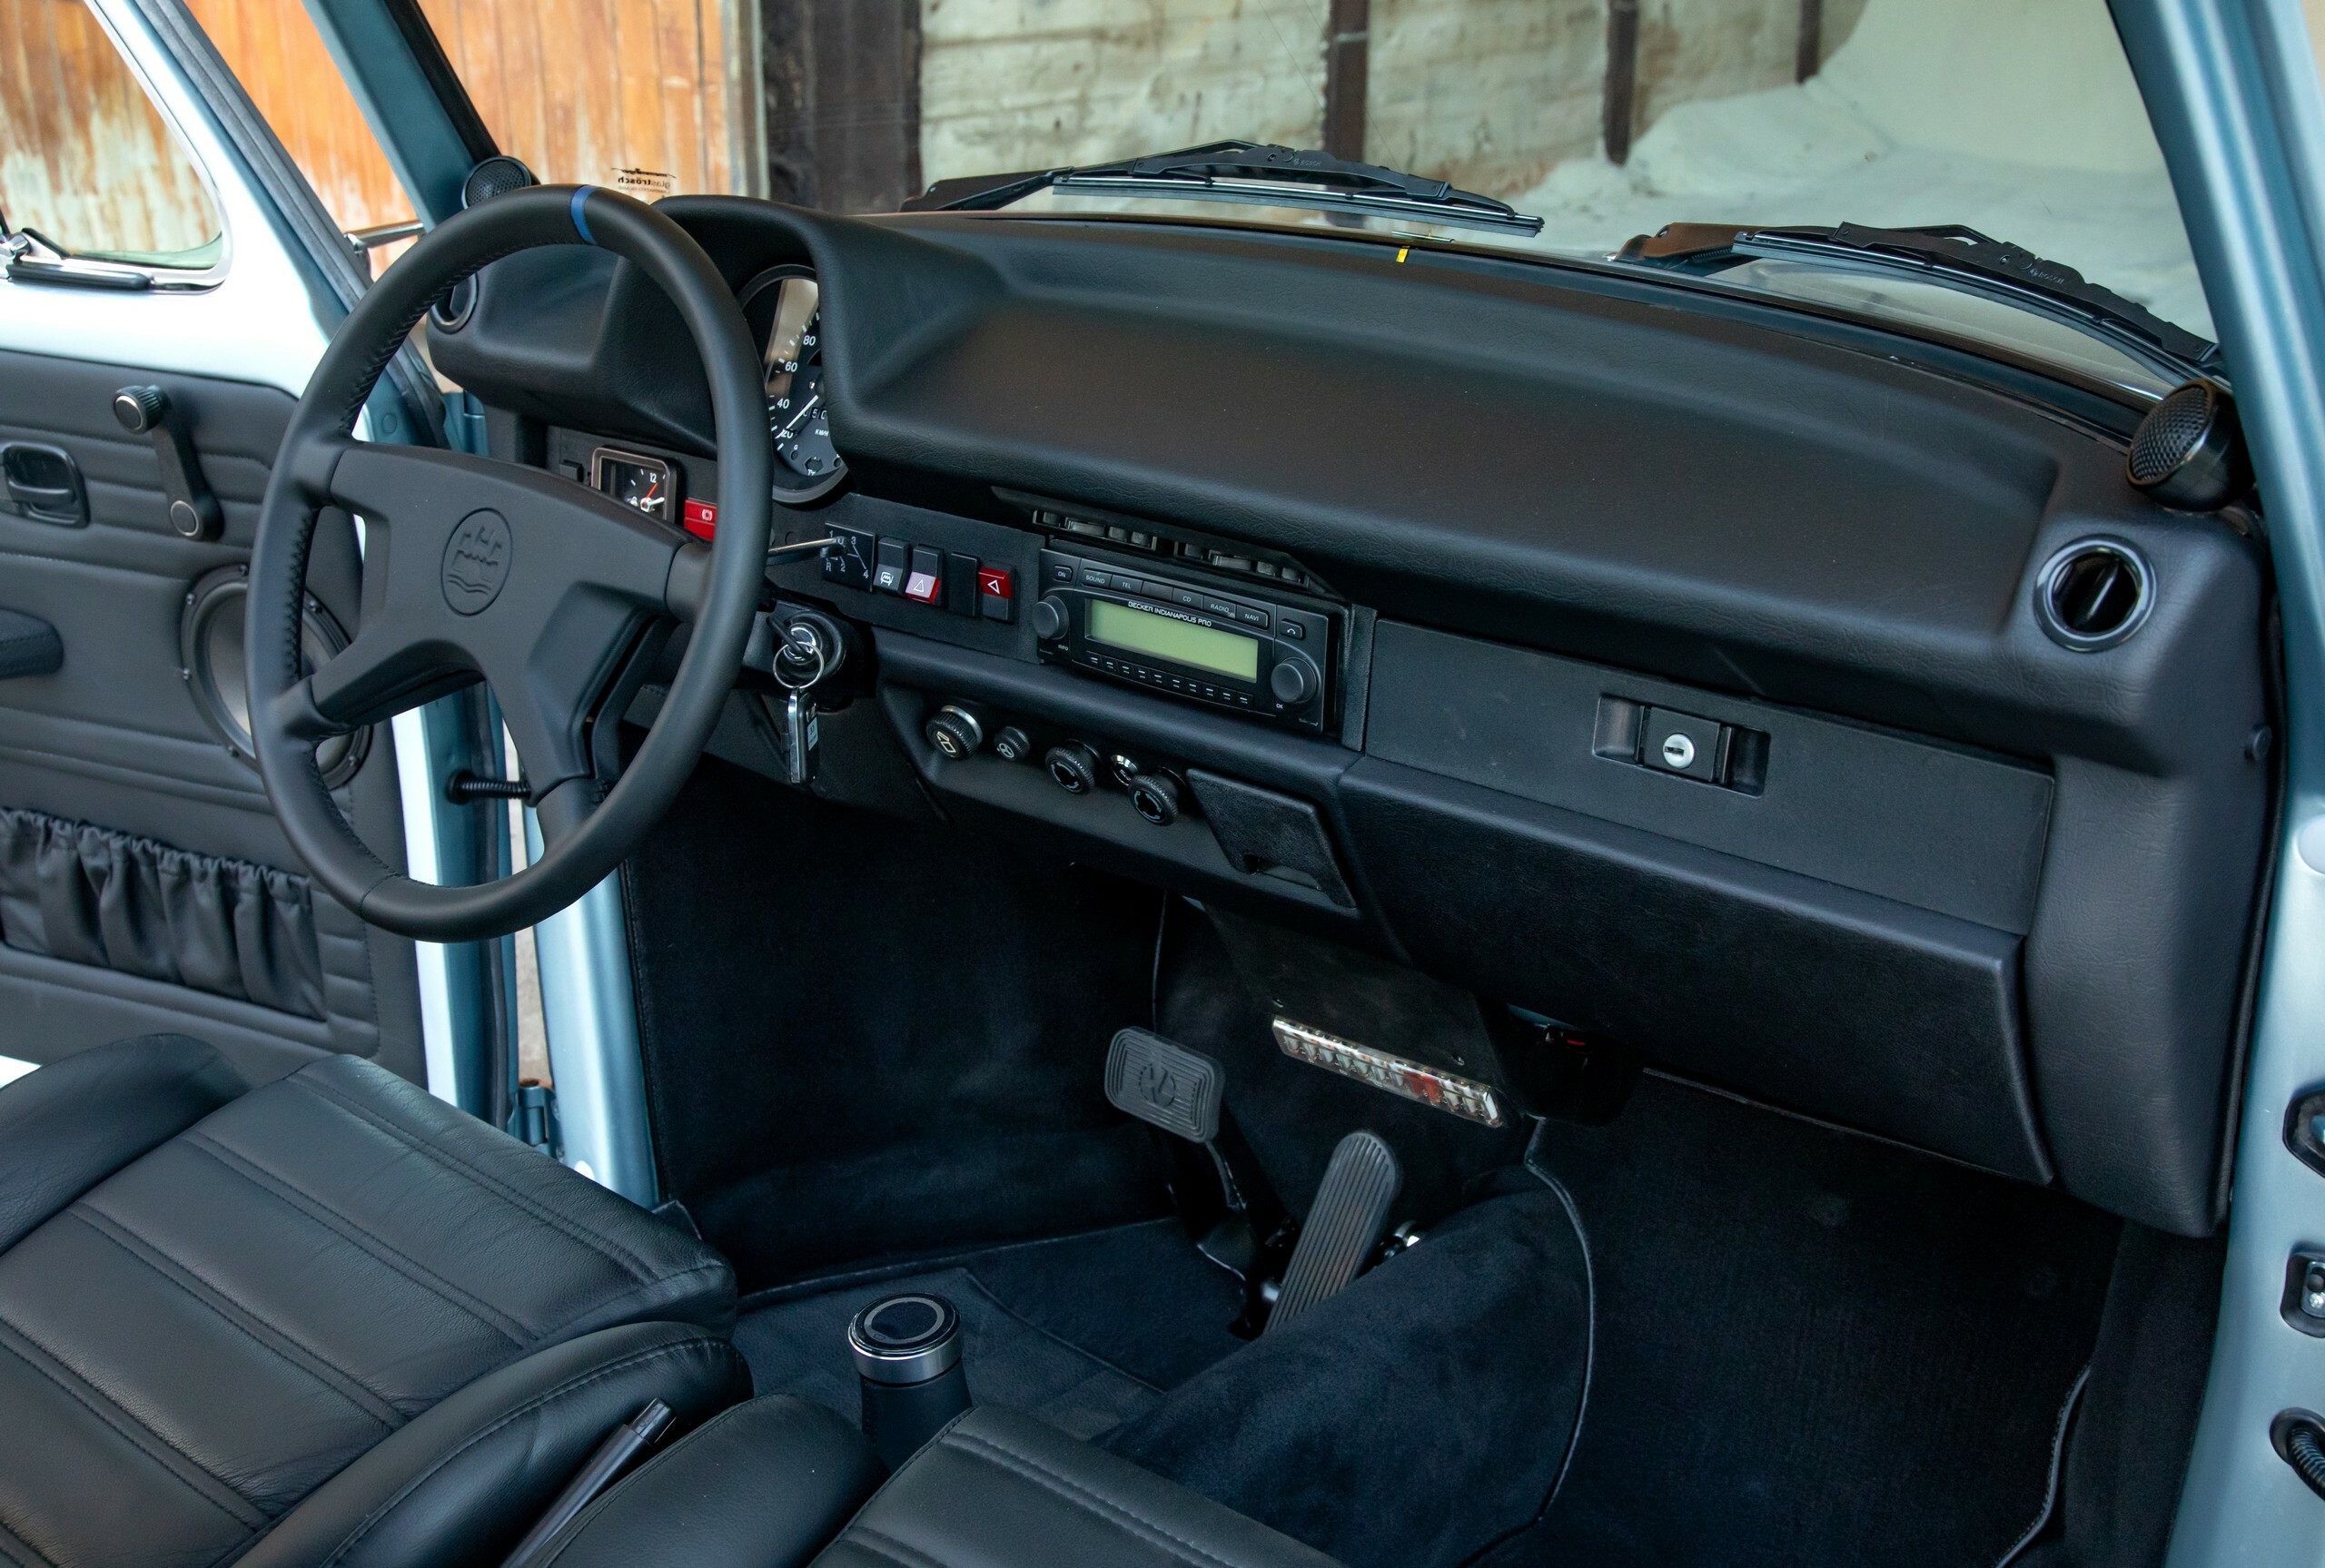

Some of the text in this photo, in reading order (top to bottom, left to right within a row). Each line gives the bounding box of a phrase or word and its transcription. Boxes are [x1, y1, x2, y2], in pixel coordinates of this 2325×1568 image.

[803, 335, 816, 346] 80
[785, 362, 797, 372] 60
[777, 398, 790, 409] 40
[815, 429, 829, 437] KM/H
[649, 472, 658, 484] 12
[829, 530, 856, 546] 1 3
[826, 562, 869, 579] R 2 4
[1085, 575, 1105, 585] SOUND
[1122, 581, 1132, 589] TEL
[1210, 603, 1230, 613] RADIO
[1128, 601, 1212, 627] BECKER INDIANAPOLIS PRO
[1244, 613, 1260, 622] NAVI
